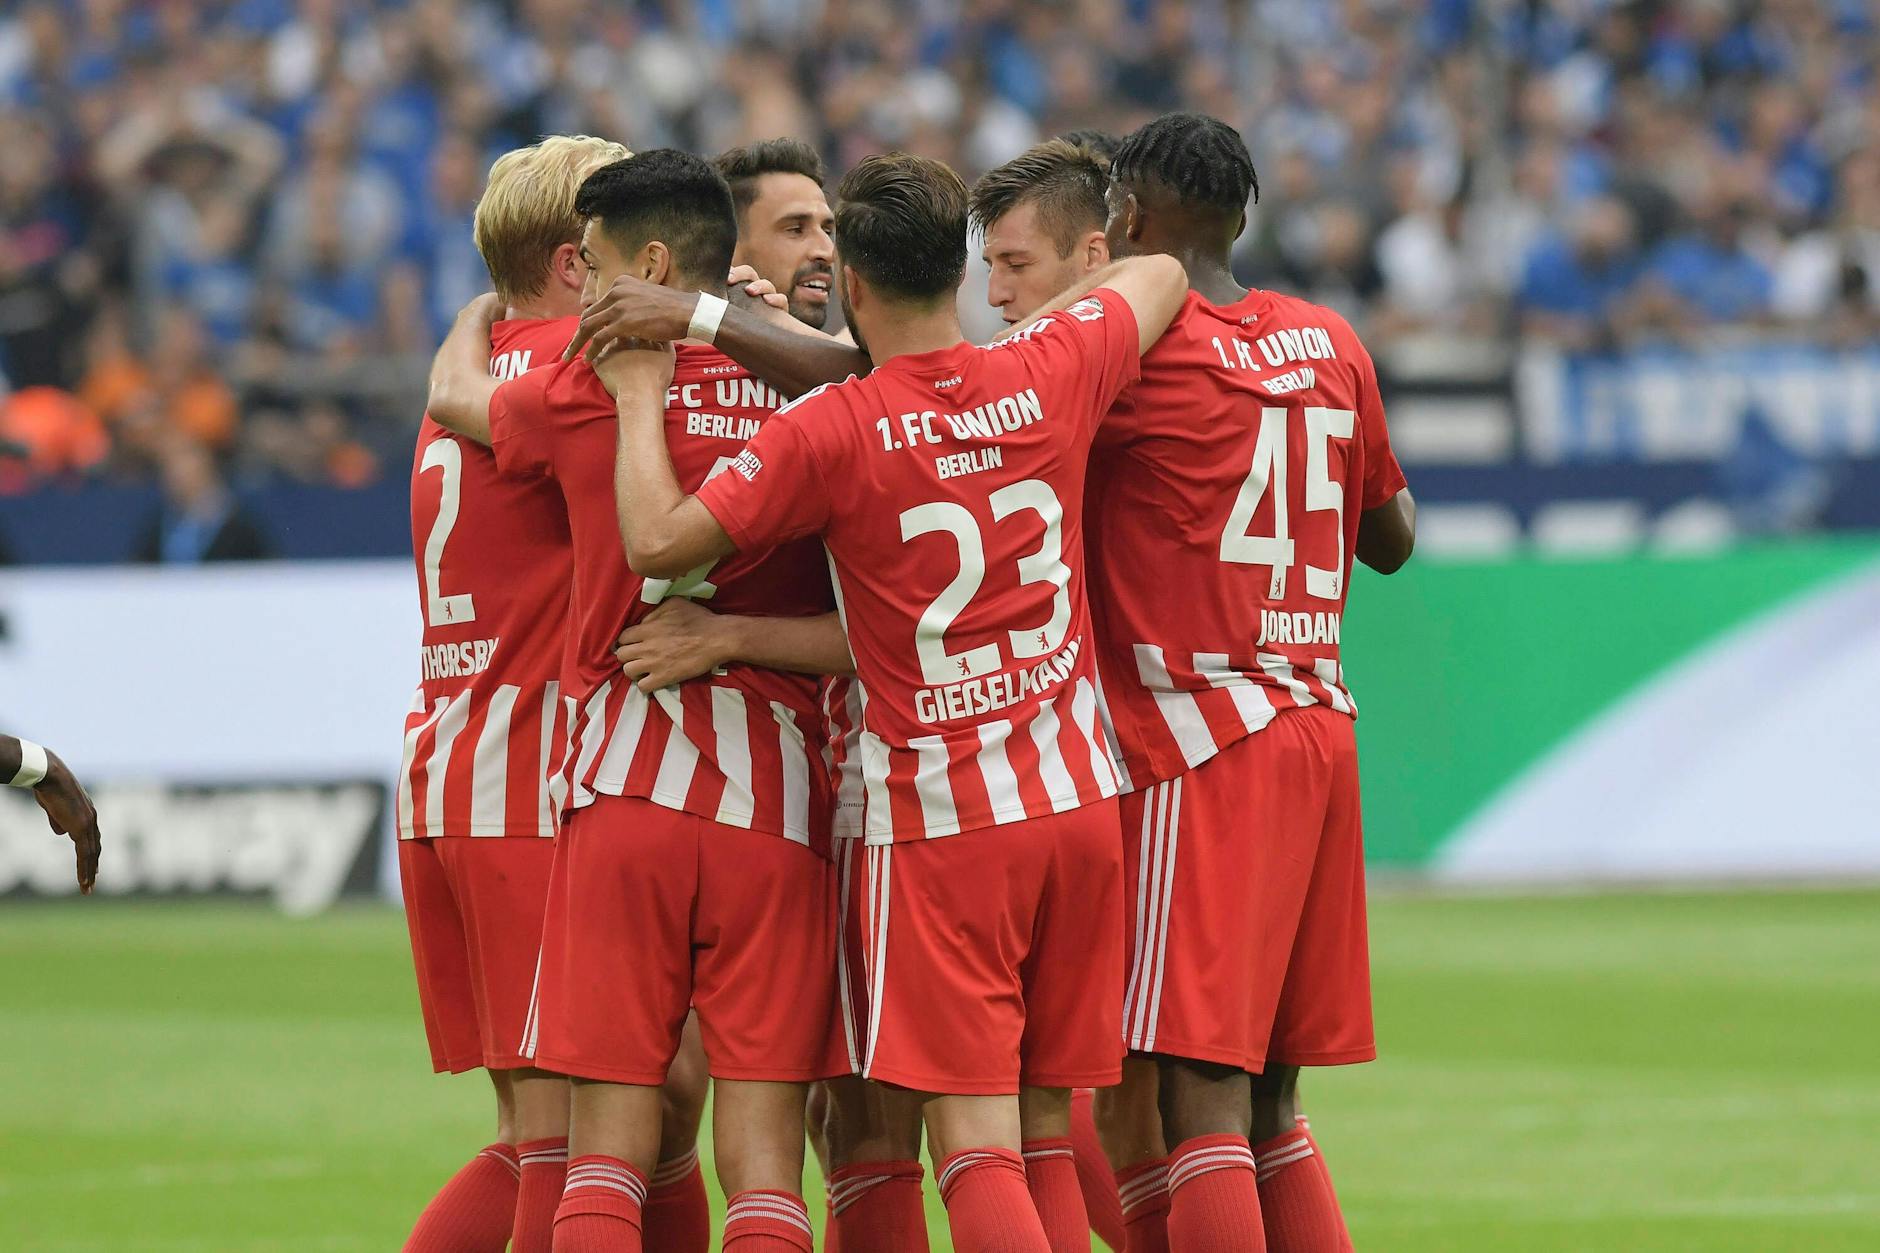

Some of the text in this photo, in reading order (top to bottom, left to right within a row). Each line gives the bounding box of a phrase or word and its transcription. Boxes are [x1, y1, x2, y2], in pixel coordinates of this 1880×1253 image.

[1256, 327, 1336, 367] UNION
[716, 378, 788, 409] UNI
[1261, 367, 1316, 395] BERLIN
[687, 412, 760, 440] BERLIN
[944, 388, 1043, 440] UNION
[738, 448, 763, 473] MEDY
[936, 446, 1003, 480] BERLIN
[1220, 407, 1354, 600] 45
[420, 438, 475, 627] 2
[899, 479, 1072, 685] 23
[1256, 609, 1340, 646] JORDAN
[421, 637, 499, 681] THORSBY
